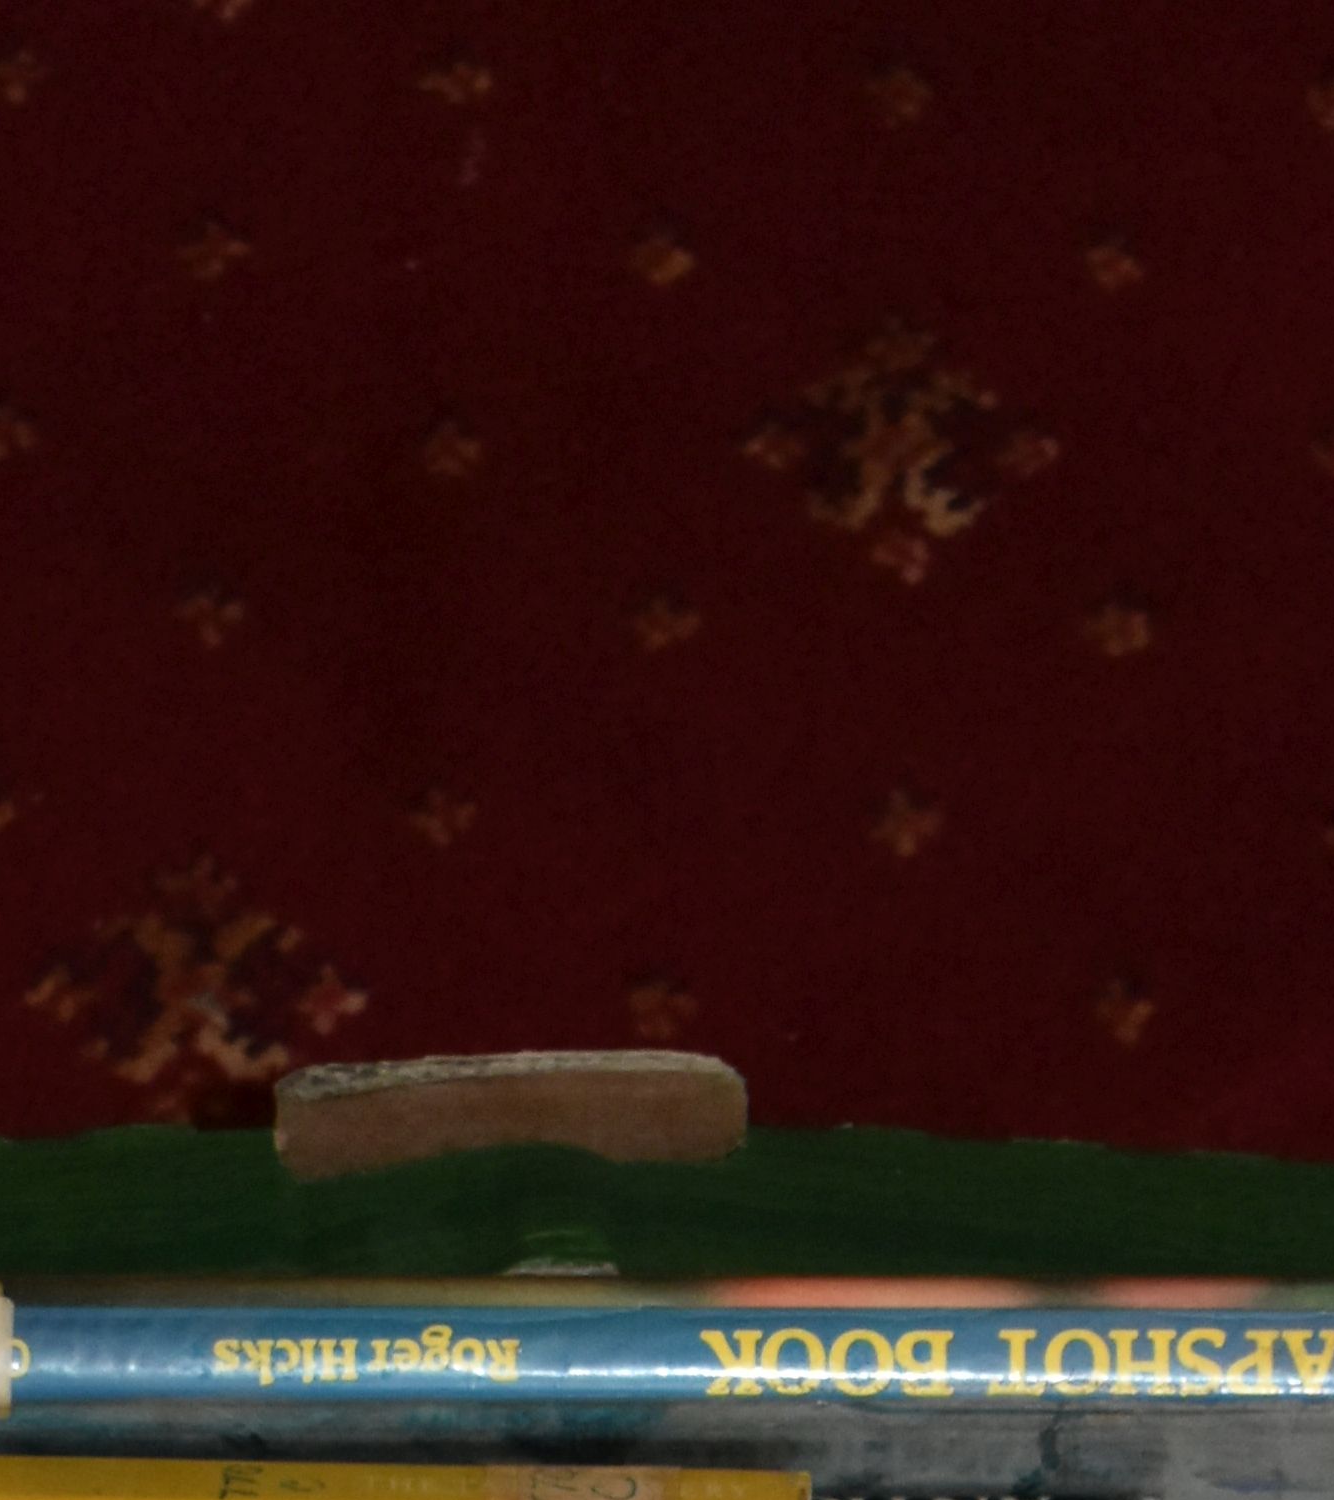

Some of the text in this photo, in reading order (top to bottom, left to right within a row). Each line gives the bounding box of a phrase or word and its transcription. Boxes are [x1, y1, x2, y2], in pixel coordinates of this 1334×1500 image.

[214, 1323, 522, 1386] Roger Hicks
[700, 1329, 954, 1397] BOOK
